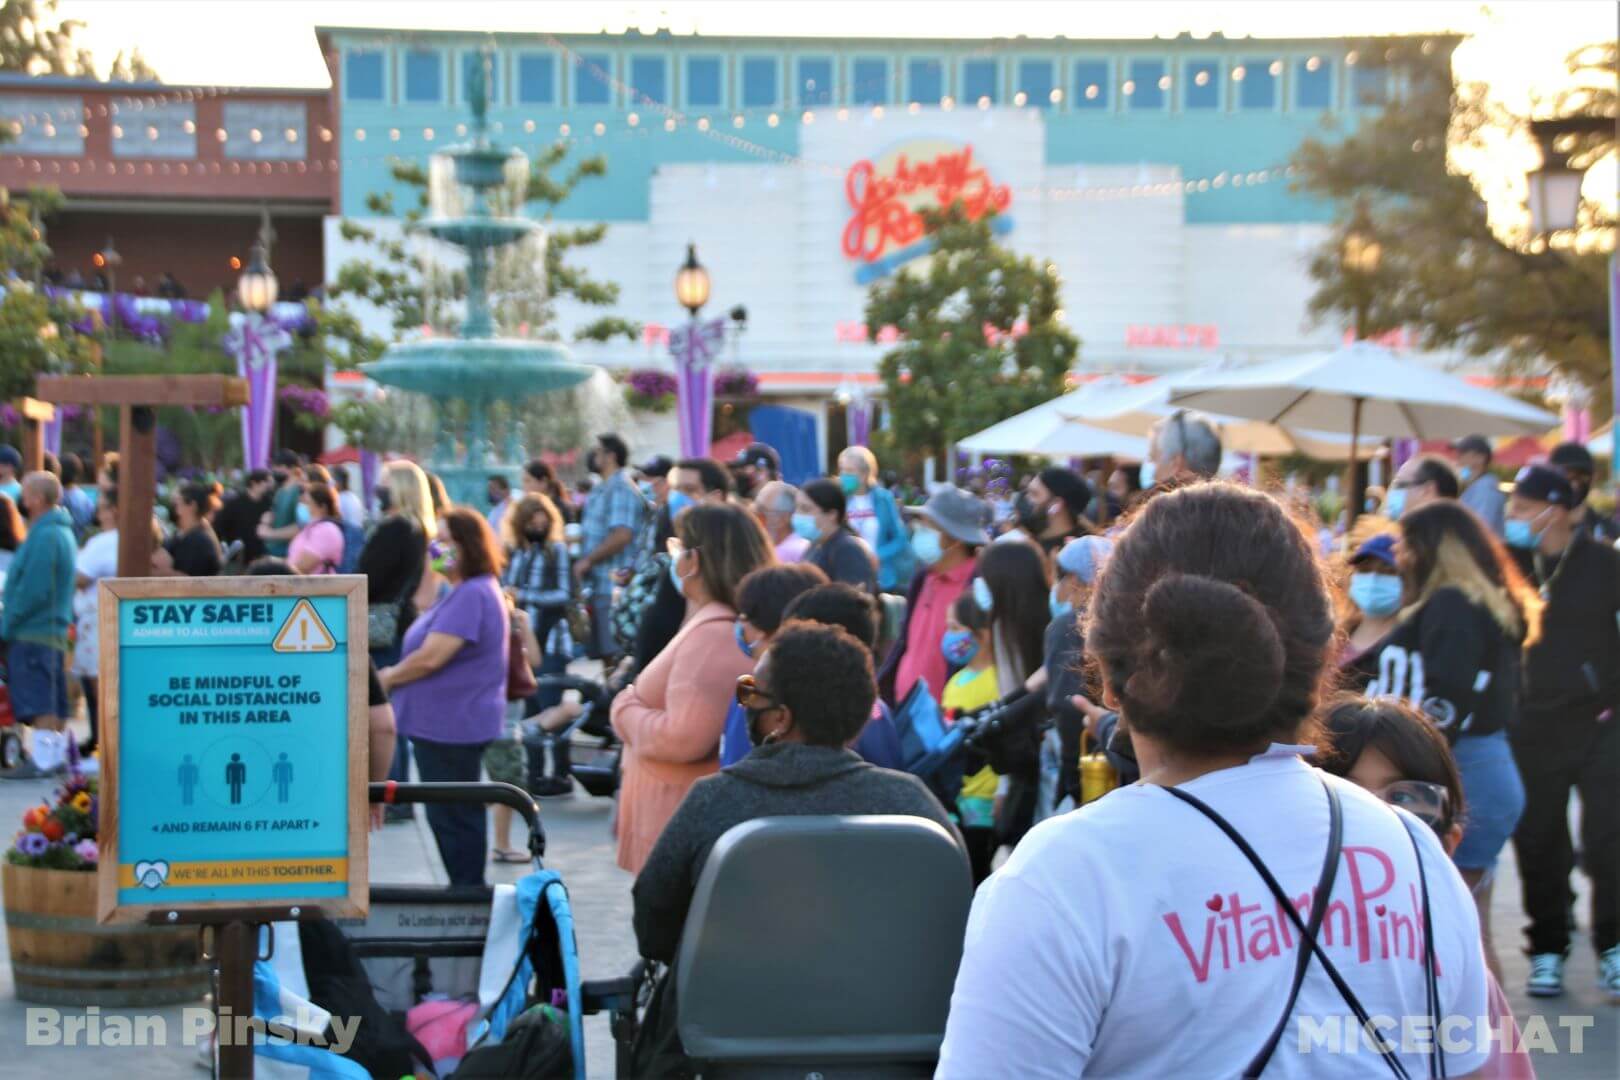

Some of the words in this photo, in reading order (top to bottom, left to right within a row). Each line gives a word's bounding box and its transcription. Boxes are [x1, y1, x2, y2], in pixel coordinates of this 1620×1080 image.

[133, 604, 196, 624] STAY
[202, 603, 274, 623] SAFE!
[132, 627, 175, 638] ADHERE
[176, 627, 191, 637] TO
[192, 627, 209, 637] ALL
[169, 676, 190, 691] BE
[195, 675, 274, 690] MINDFUL
[278, 674, 301, 689] OF
[148, 693, 211, 707] SOCIAL
[215, 691, 321, 706] DISTANCING
[179, 711, 198, 725] IN
[202, 711, 241, 725] THIS
[245, 710, 291, 724] AREA
[161, 822, 191, 833] AND
[192, 821, 241, 833] REMAIN
[244, 820, 252, 832] 6
[255, 820, 270, 831] FT
[271, 819, 311, 831] APART
[174, 868, 208, 880] WE'RE
[210, 867, 229, 879] ALL
[232, 866, 244, 878] IN
[246, 865, 271, 877] THIS
[273, 864, 336, 876] TOGETHER.
